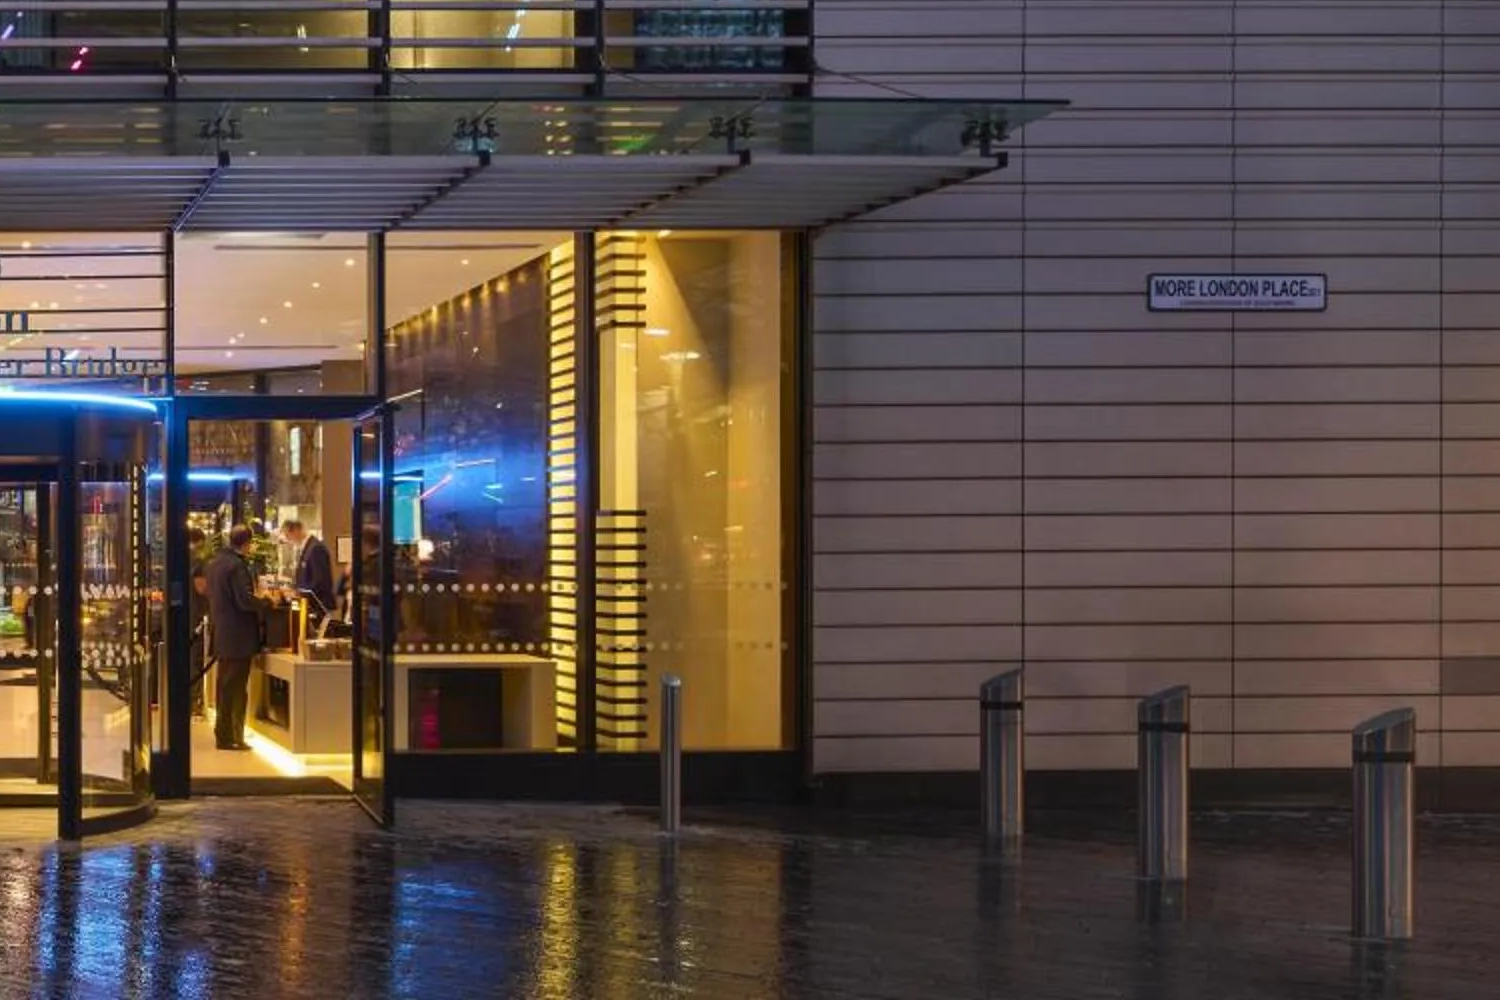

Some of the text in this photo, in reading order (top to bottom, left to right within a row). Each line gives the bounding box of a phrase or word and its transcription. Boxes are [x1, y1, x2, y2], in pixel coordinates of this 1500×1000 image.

[1154, 279, 1195, 297] MORE
[1199, 279, 1259, 297] LONDON
[1262, 279, 1308, 297] PLACE
